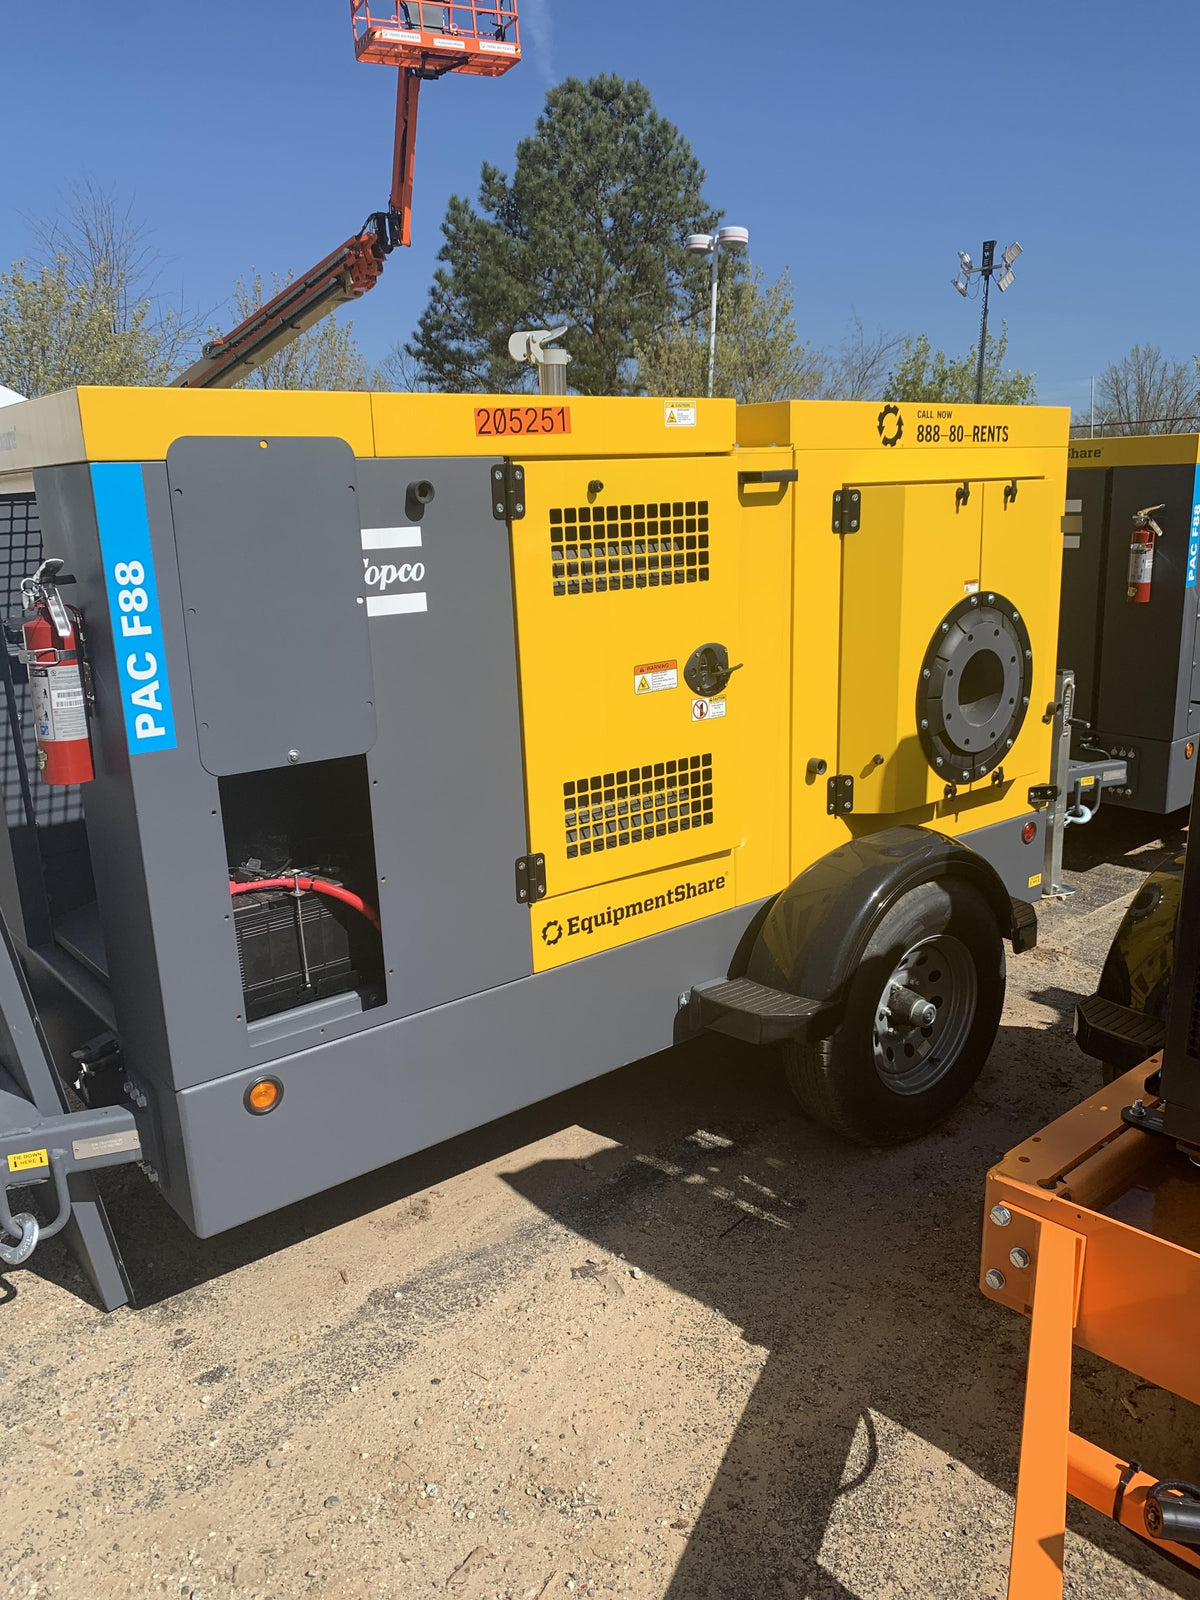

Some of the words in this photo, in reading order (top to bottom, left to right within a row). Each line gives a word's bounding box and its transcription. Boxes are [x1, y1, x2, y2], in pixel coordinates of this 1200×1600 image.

[476, 406, 566, 434] 205251
[917, 410, 934, 419] CALL
[937, 410, 953, 420] NOW
[916, 424, 1009, 443] 888-80-RENTS
[1191, 504, 1200, 537] F88
[362, 558, 425, 591] opco
[1188, 543, 1198, 581] PAC
[114, 560, 153, 637] F88
[646, 663, 670, 671] WARNING
[126, 652, 166, 739] PAC
[567, 875, 726, 936] EquipmentShare
